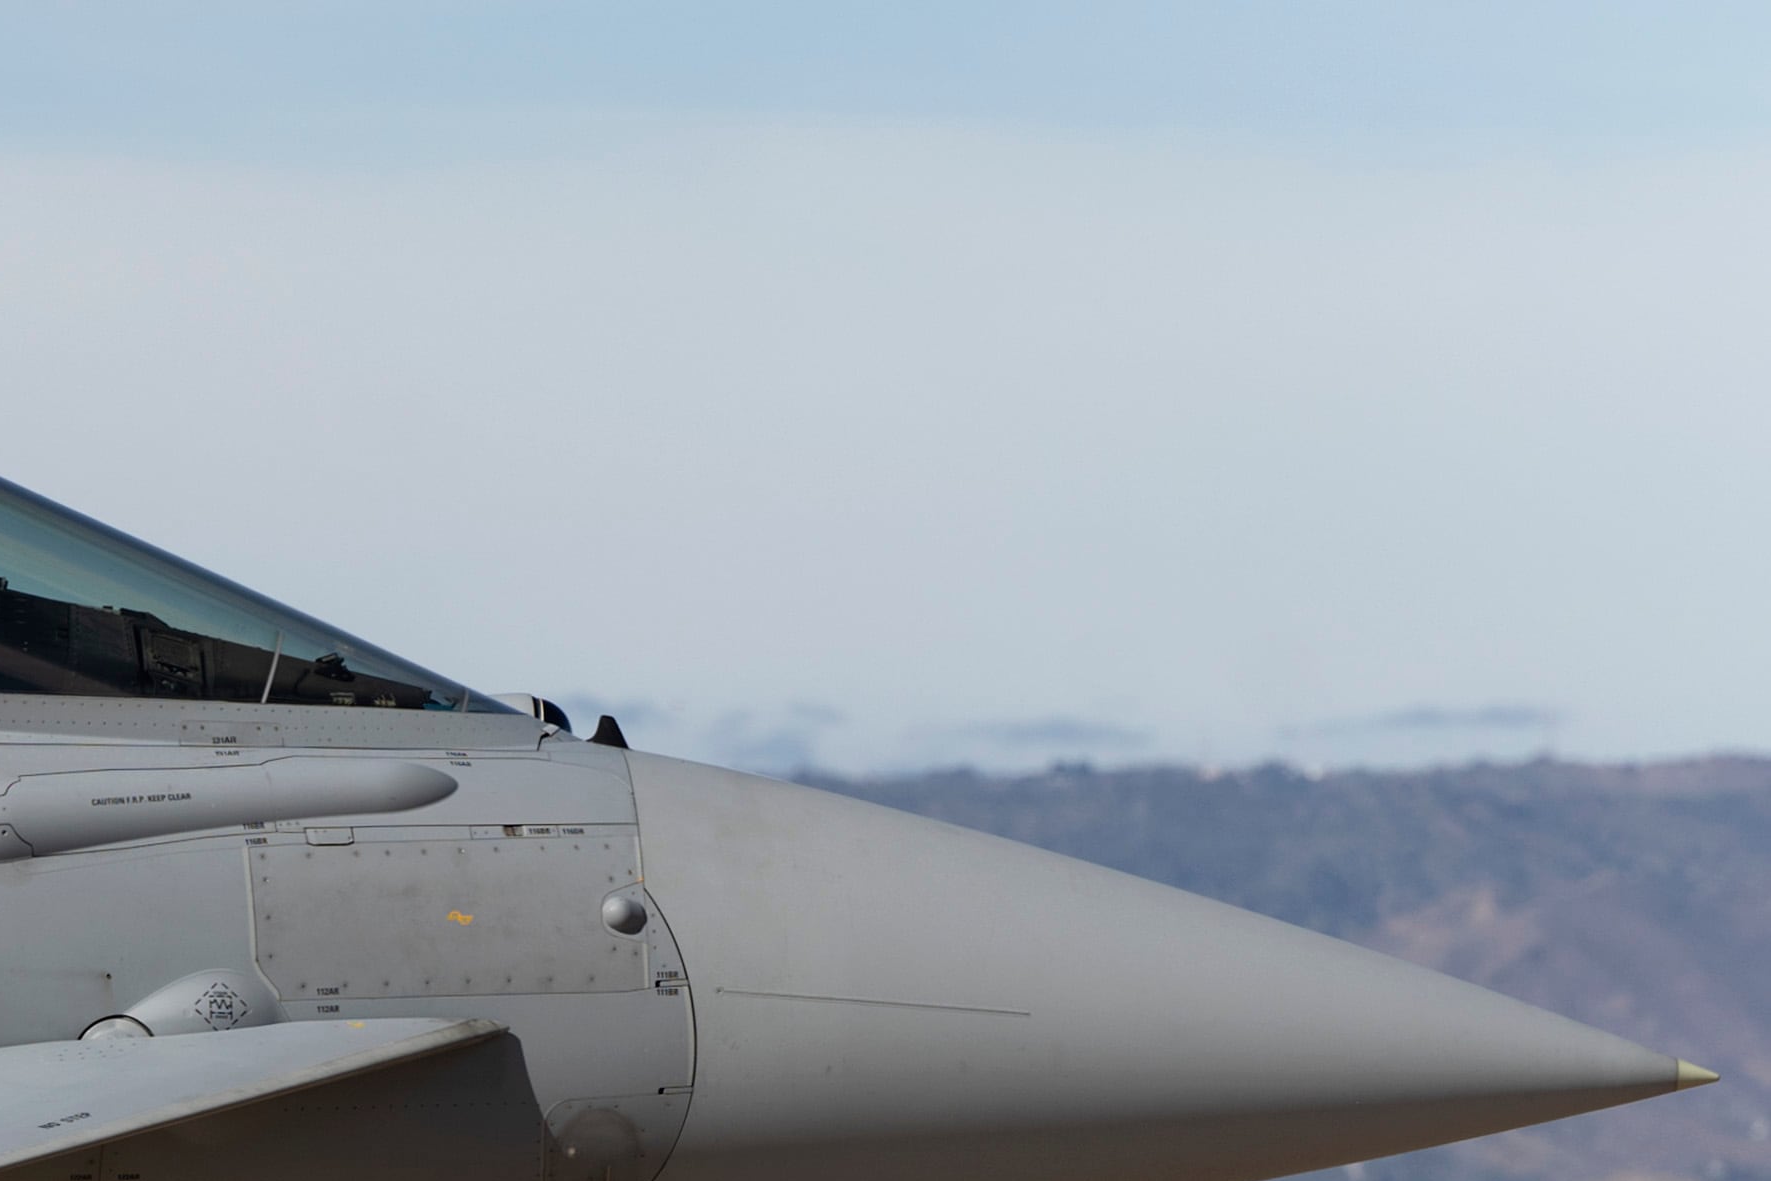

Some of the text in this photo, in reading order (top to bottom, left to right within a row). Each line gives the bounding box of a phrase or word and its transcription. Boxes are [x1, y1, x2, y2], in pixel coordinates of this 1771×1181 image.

[91, 797, 125, 806] CAUTION
[147, 794, 166, 802] KEEP
[167, 792, 191, 800] CLEAR
